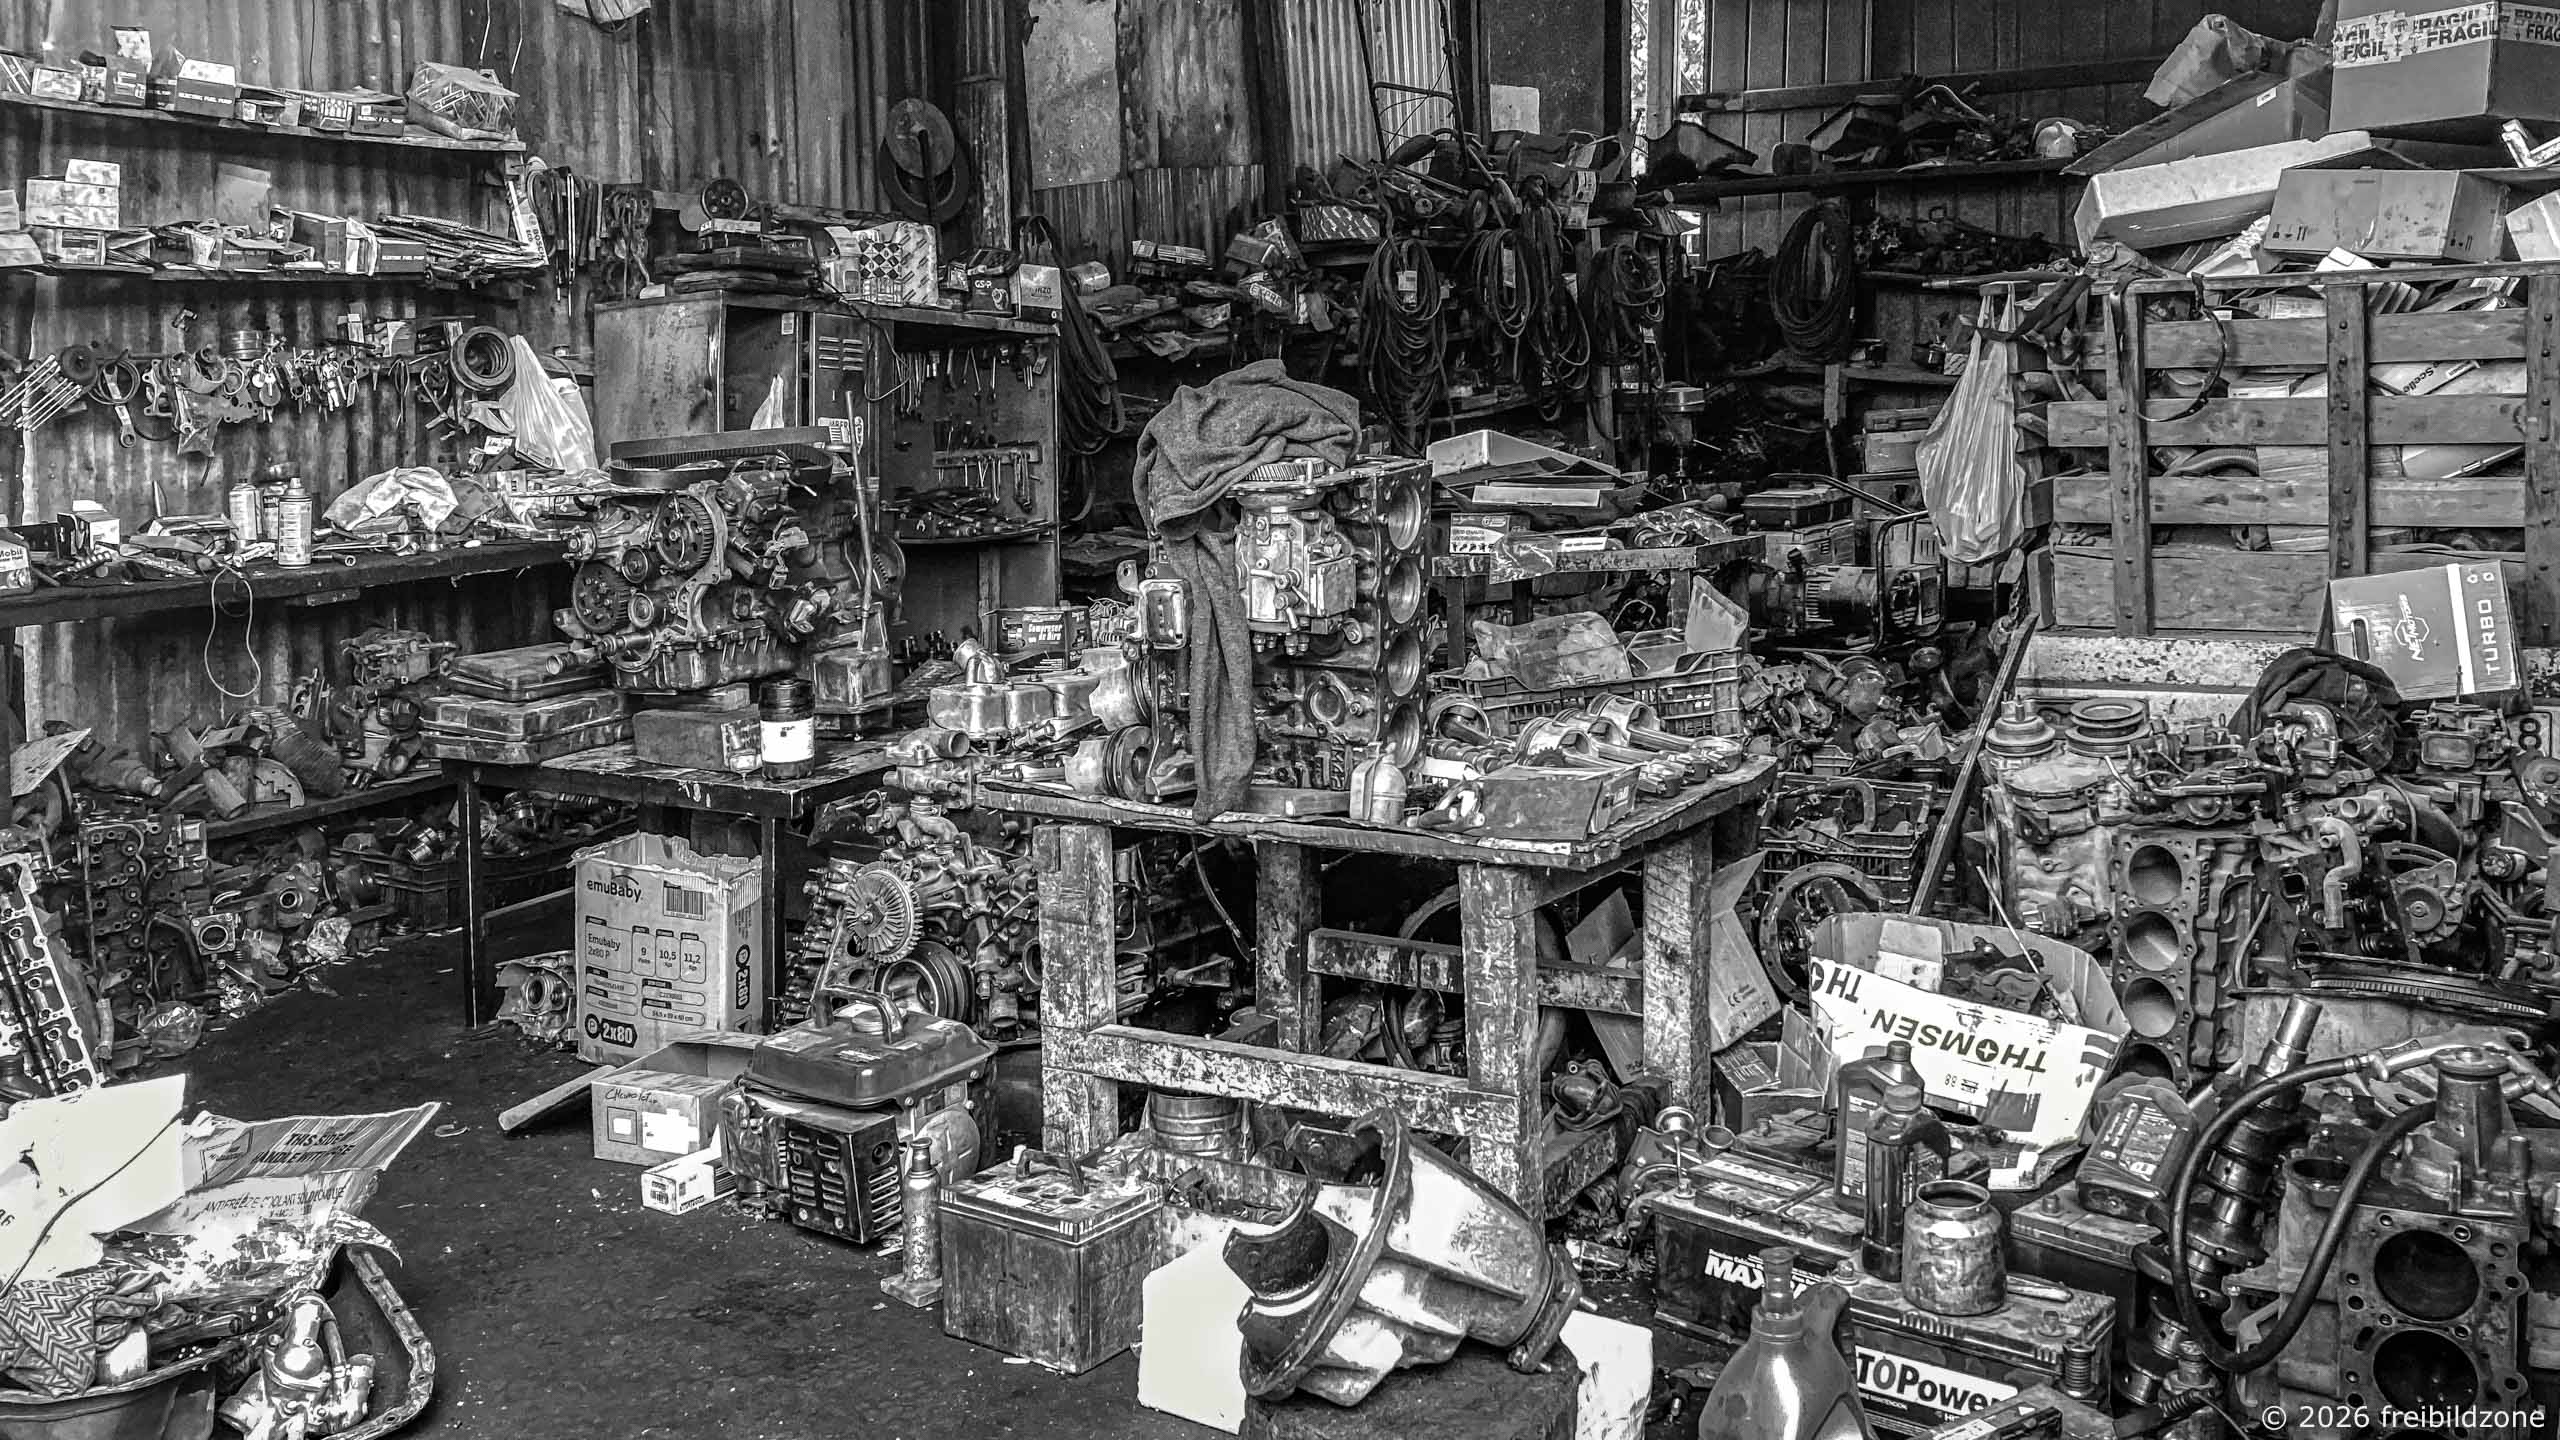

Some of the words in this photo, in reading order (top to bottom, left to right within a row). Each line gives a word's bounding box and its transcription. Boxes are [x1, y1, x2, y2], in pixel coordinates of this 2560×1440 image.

[2427, 20, 2499, 48] FRAGIL
[533, 228, 546, 259] BOSCH
[2477, 599, 2500, 676] TURBO
[586, 879, 642, 903] emuBaby
[641, 947, 647, 956] 9
[659, 950, 677, 961] 10,5
[684, 952, 701, 964] 11,2
[602, 1022, 634, 1044] 2x80
[1870, 1008, 2047, 1073] THOMSEN
[286, 1132, 317, 1147] THIS
